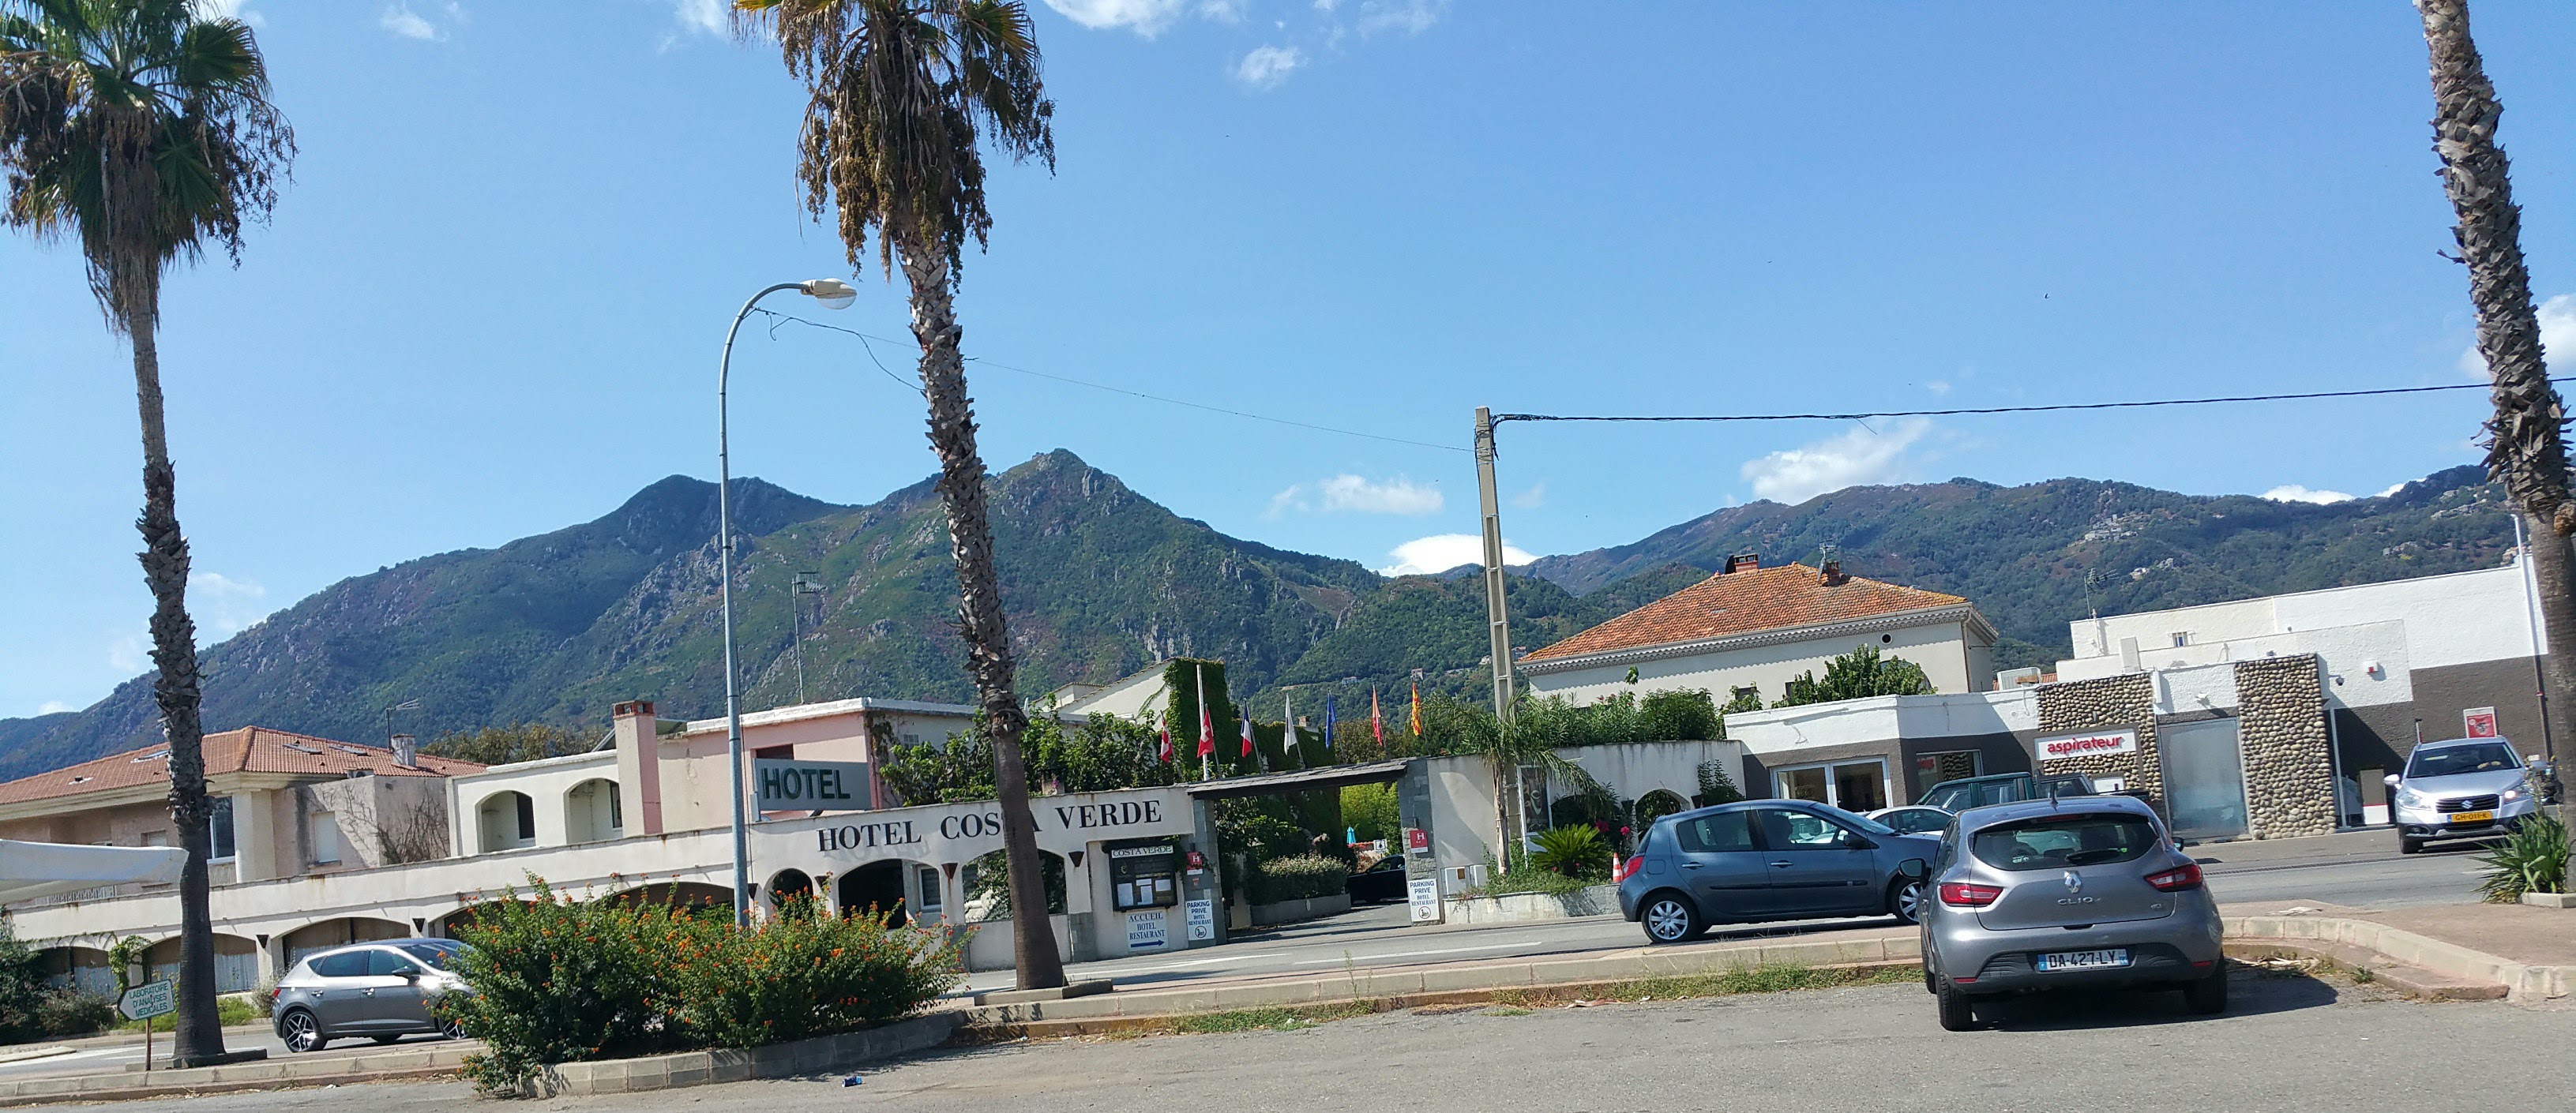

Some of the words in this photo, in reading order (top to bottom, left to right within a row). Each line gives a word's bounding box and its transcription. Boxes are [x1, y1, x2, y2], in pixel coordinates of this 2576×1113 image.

[2047, 736, 2123, 754] aspirateur
[762, 767, 851, 800] HOTEL
[817, 820, 922, 852] HOTEL
[940, 811, 1042, 840] COS
[1055, 800, 1162, 830] VERDE
[1113, 849, 1142, 857] COSTA
[1143, 845, 1172, 854] VERDE
[2057, 897, 2093, 905] CLIO
[1128, 912, 1163, 922] ACCUEIL
[1137, 922, 1157, 931] HOTEL
[1129, 929, 1166, 940] RESTAURANT
[2048, 950, 2116, 969] DA-427-LY
[129, 982, 168, 999] LABORATOIRE
[133, 992, 167, 1008] D'ANALYSES
[135, 1002, 168, 1017] MEDICALES
